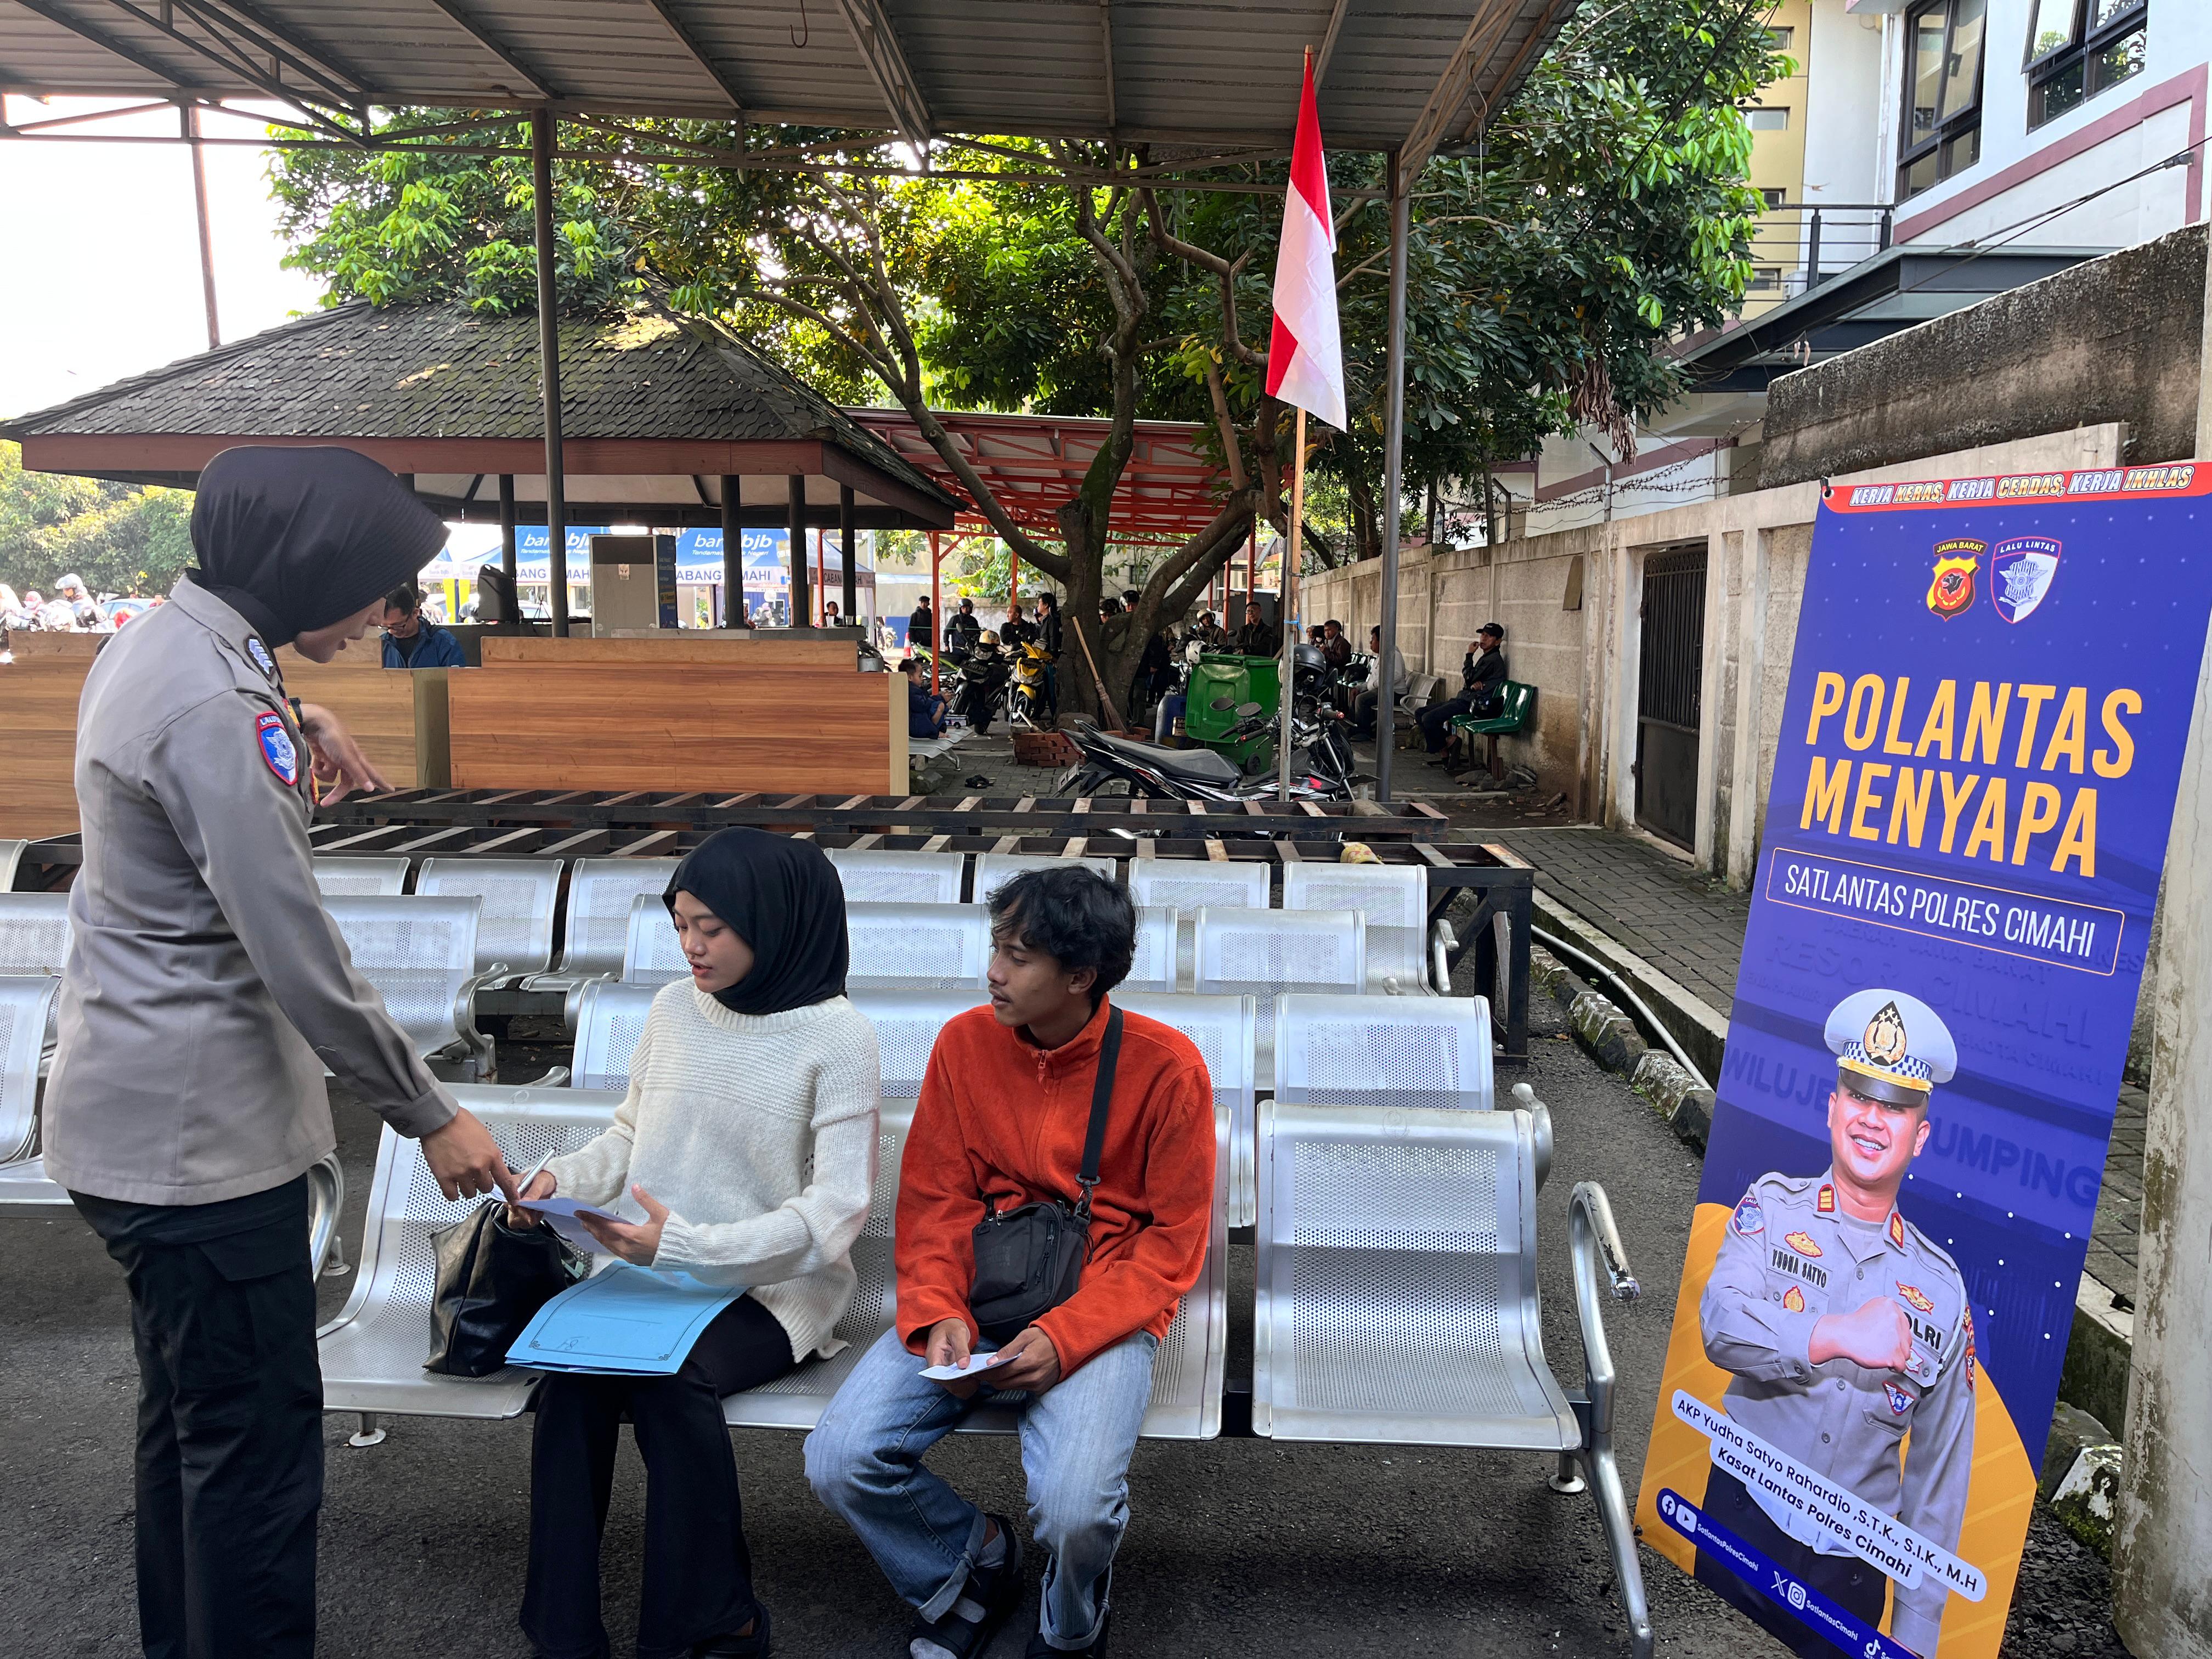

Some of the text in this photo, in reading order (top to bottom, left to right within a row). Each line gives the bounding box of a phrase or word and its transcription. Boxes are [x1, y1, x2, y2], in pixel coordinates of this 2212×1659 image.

[1850, 466, 2194, 506] KERJA KERAS, KERJA CERDAS, KERJA IKHLAS
[742, 534, 772, 550] bjb
[1937, 541, 1984, 553] JAWA BARAT
[2000, 541, 2056, 554] LALU LINTAS
[676, 571, 721, 580] ABANG
[823, 573, 843, 584] CABAN
[1805, 672, 2142, 779] POLANTAS
[1799, 756, 2097, 878] MENYAPA
[1785, 864, 2096, 957] SATLANTAS POLRES CIMAHI
[1723, 1047, 2102, 1207] WILUJE UMPING
[1772, 1249, 1827, 1288] YUDHA SATYO
[1678, 1400, 1700, 1419] AKP
[1704, 1413, 1743, 1447] Yudha
[1746, 1441, 1783, 1472] Satyo
[1786, 1465, 1850, 1514] Rahardjo
[1946, 1563, 1977, 1592] M.H
[1718, 1447, 1912, 1578] Kasat Lantas Polres Cimahi
[1697, 1523, 1759, 1572] SatlantasPolresCimahi
[1806, 1600, 1859, 1641] SatlantasCimahi
